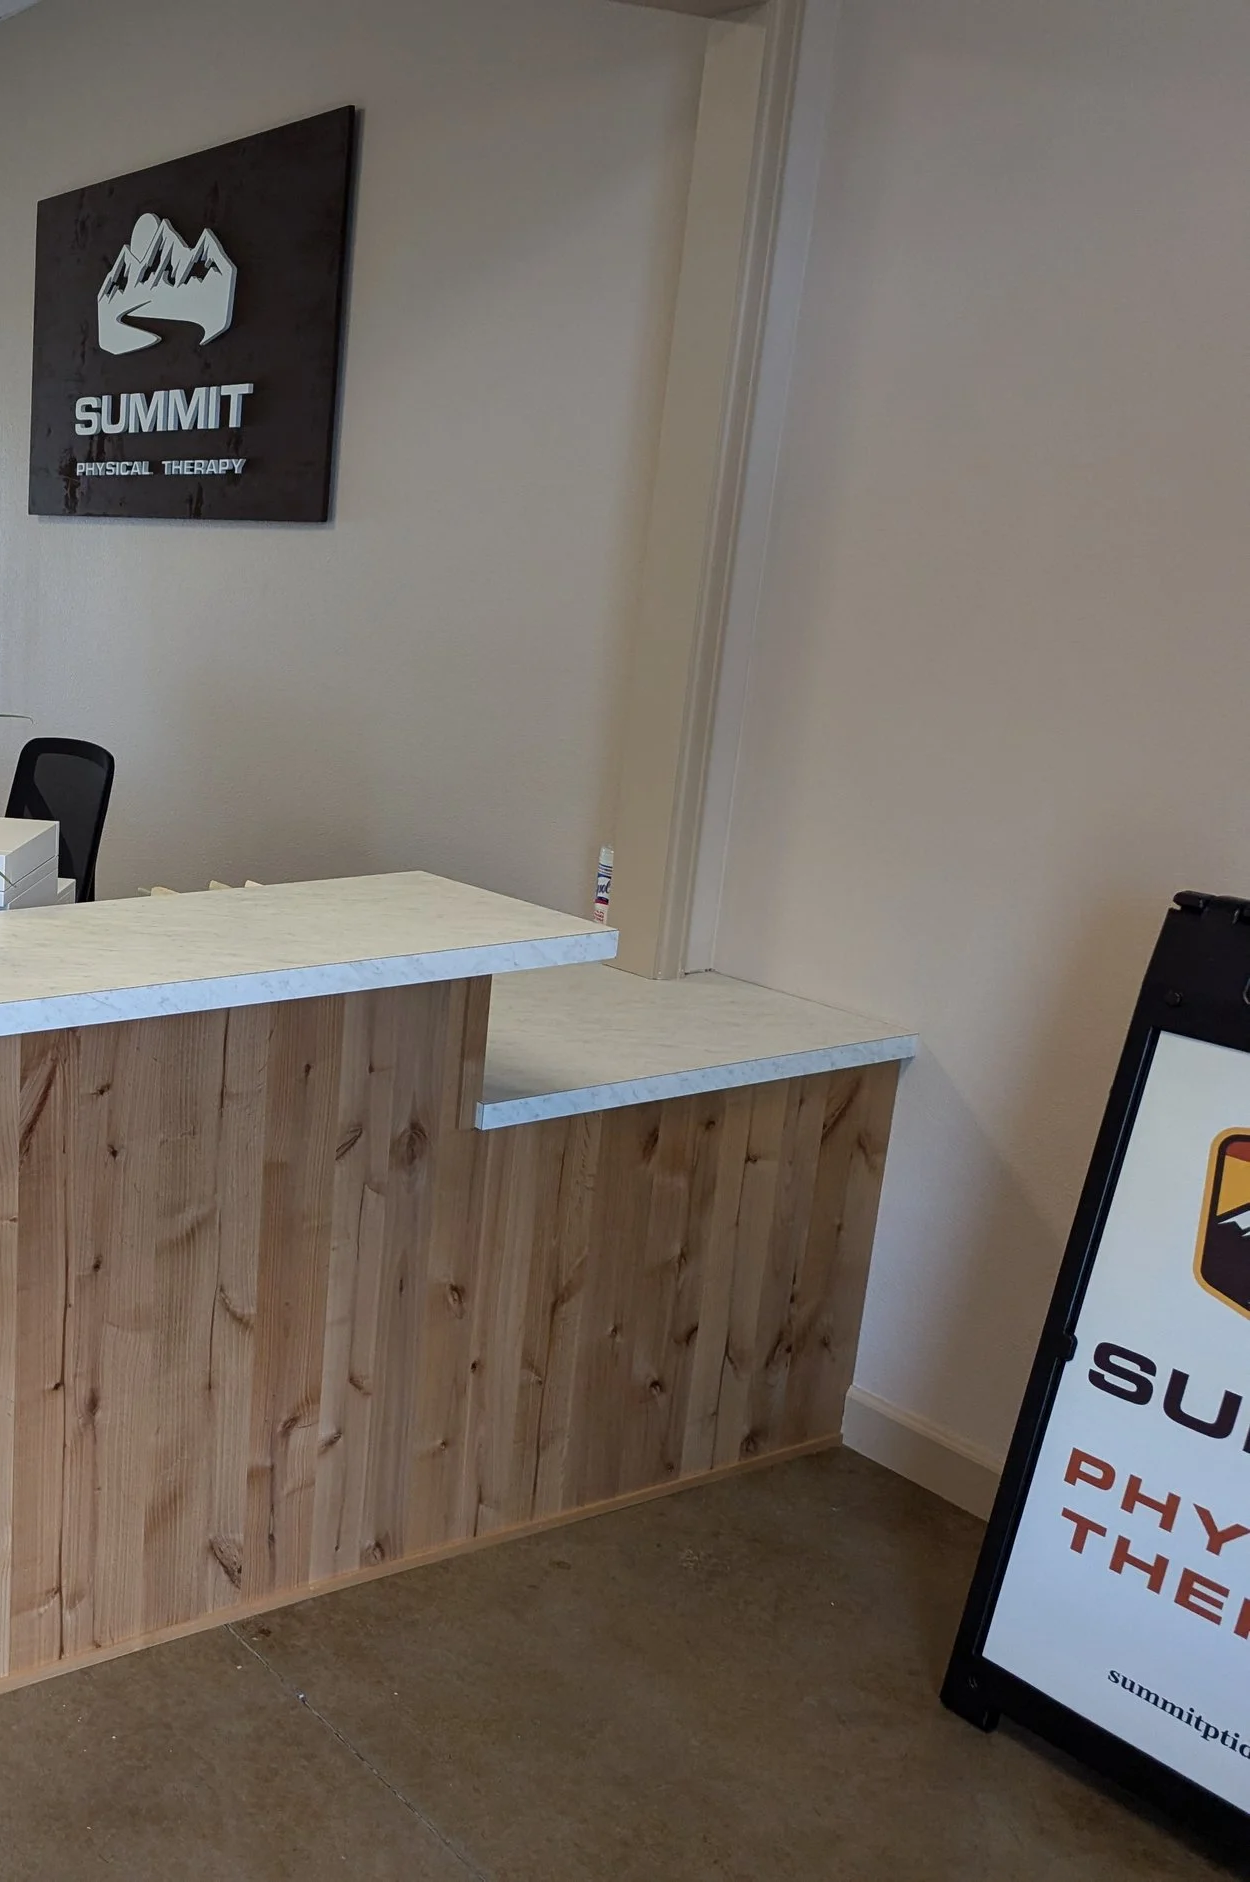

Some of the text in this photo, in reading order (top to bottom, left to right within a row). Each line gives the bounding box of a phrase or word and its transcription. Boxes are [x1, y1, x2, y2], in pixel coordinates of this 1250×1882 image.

[75, 383, 253, 435] SUMMIT
[77, 459, 246, 476] PHYSICAL THERAPY
[1088, 1341, 1250, 1454] SU
